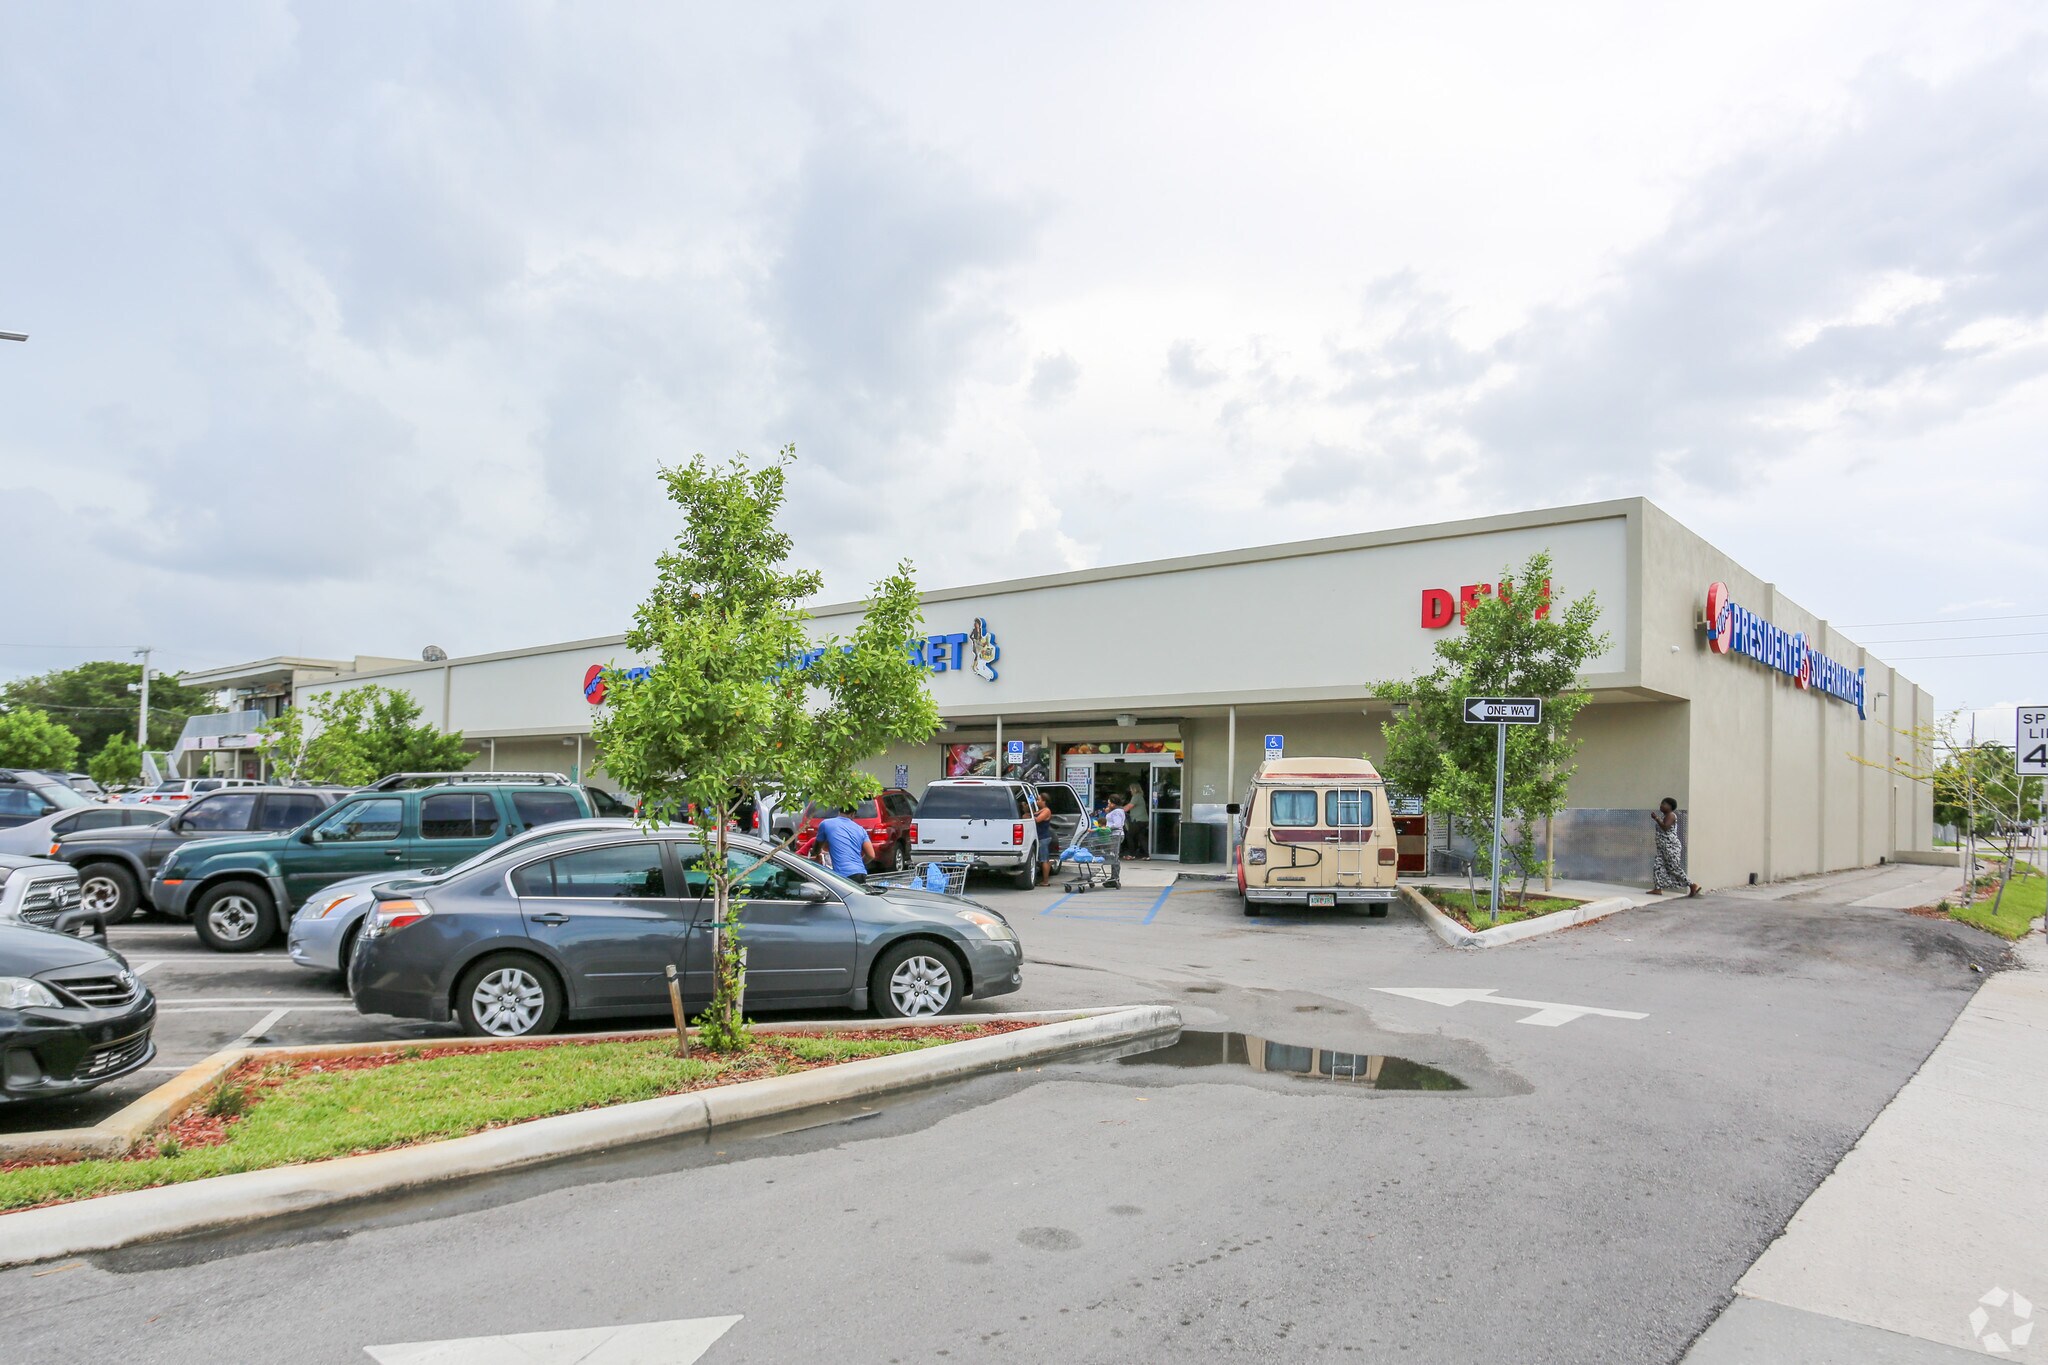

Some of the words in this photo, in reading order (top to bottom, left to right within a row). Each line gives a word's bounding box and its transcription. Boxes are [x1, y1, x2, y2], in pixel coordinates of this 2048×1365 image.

[1732, 603, 1799, 678] PRESIDENTE
[1811, 648, 1863, 707] SUPERMARKET
[1487, 706, 1507, 715] ONE
[1510, 706, 1531, 715] WAY
[2029, 728, 2048, 739] LI
